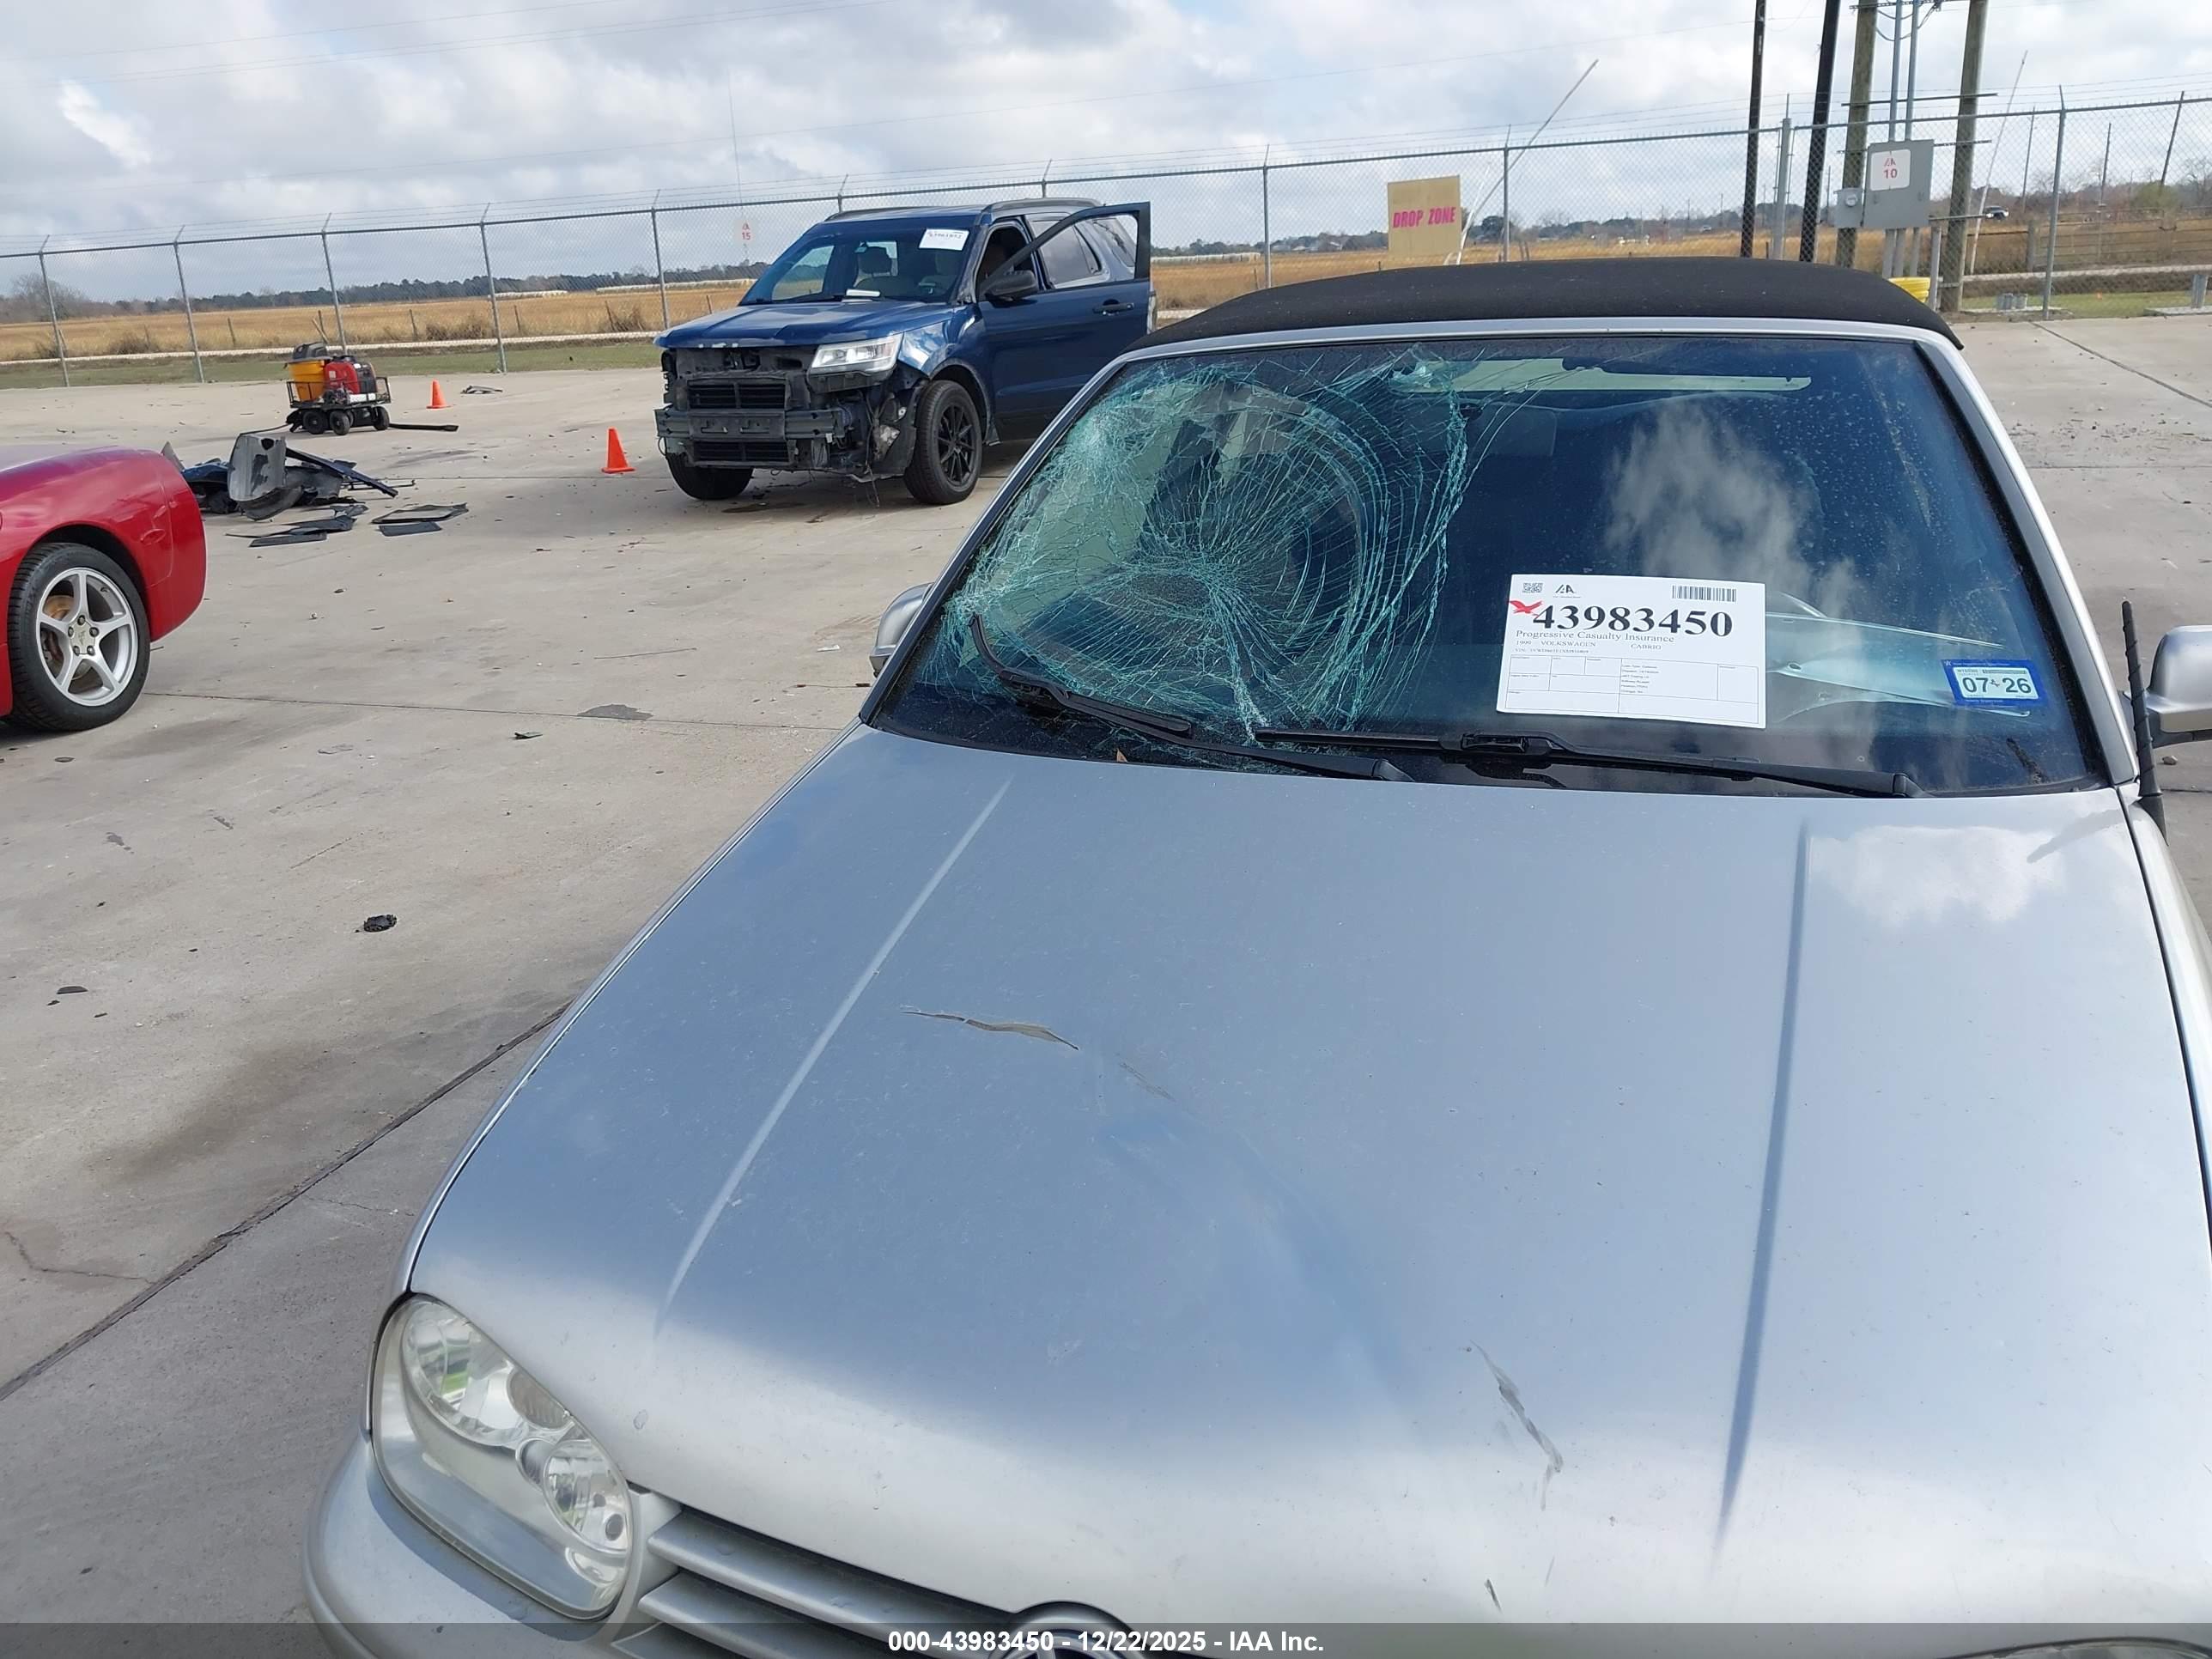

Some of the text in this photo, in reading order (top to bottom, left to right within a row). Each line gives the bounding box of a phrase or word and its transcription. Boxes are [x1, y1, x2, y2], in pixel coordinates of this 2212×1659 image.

[1883, 168, 1898, 179] 10
[1393, 207, 1456, 228] DROP ZONE
[742, 232, 751, 240] 15
[1533, 605, 1733, 637] 43983450
[1516, 629, 1675, 643] Progressive Casualty Insurance
[1962, 677, 2032, 694] 07 26
